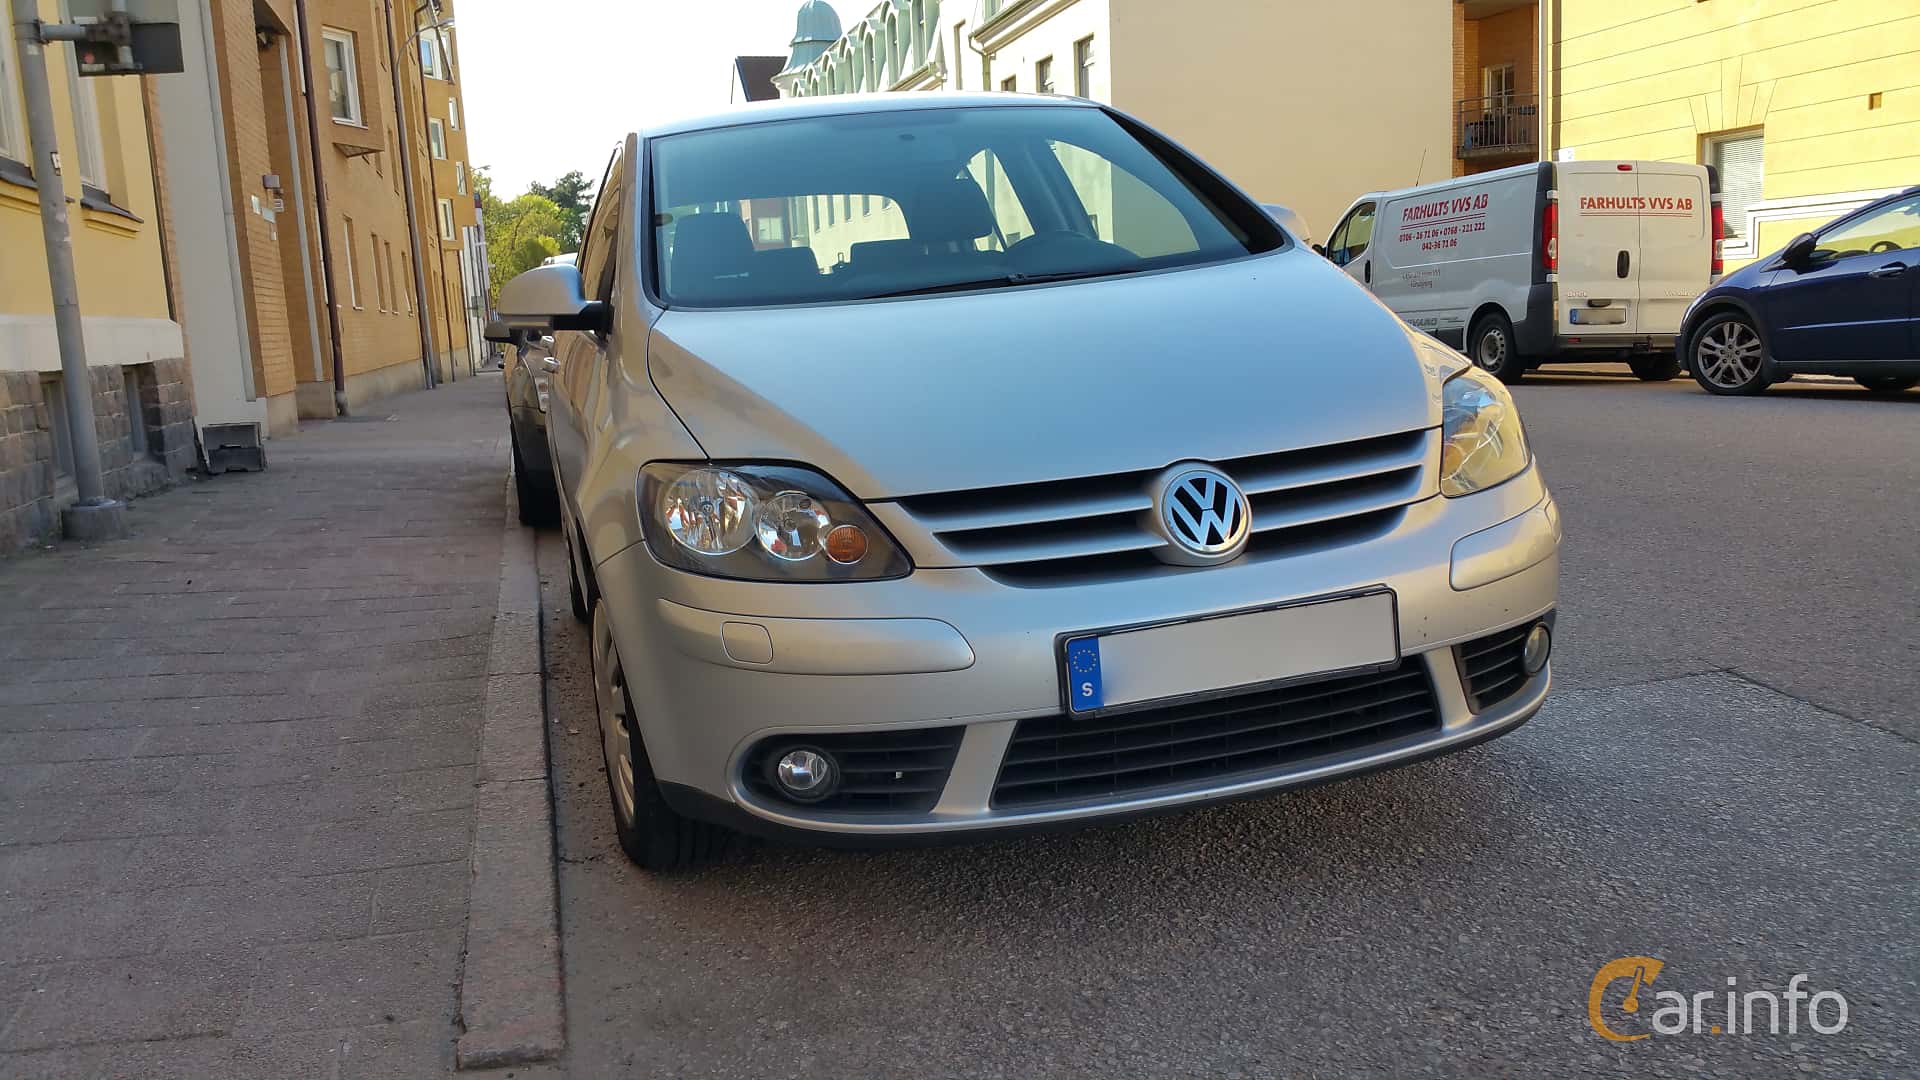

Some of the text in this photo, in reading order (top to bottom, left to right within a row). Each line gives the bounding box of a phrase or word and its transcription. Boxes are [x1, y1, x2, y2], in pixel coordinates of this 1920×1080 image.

[1402, 193, 1488, 222] FARHULTS VVS AB
[1580, 197, 1693, 210] FARHULTS VVS AB
[1081, 682, 1093, 697] S
